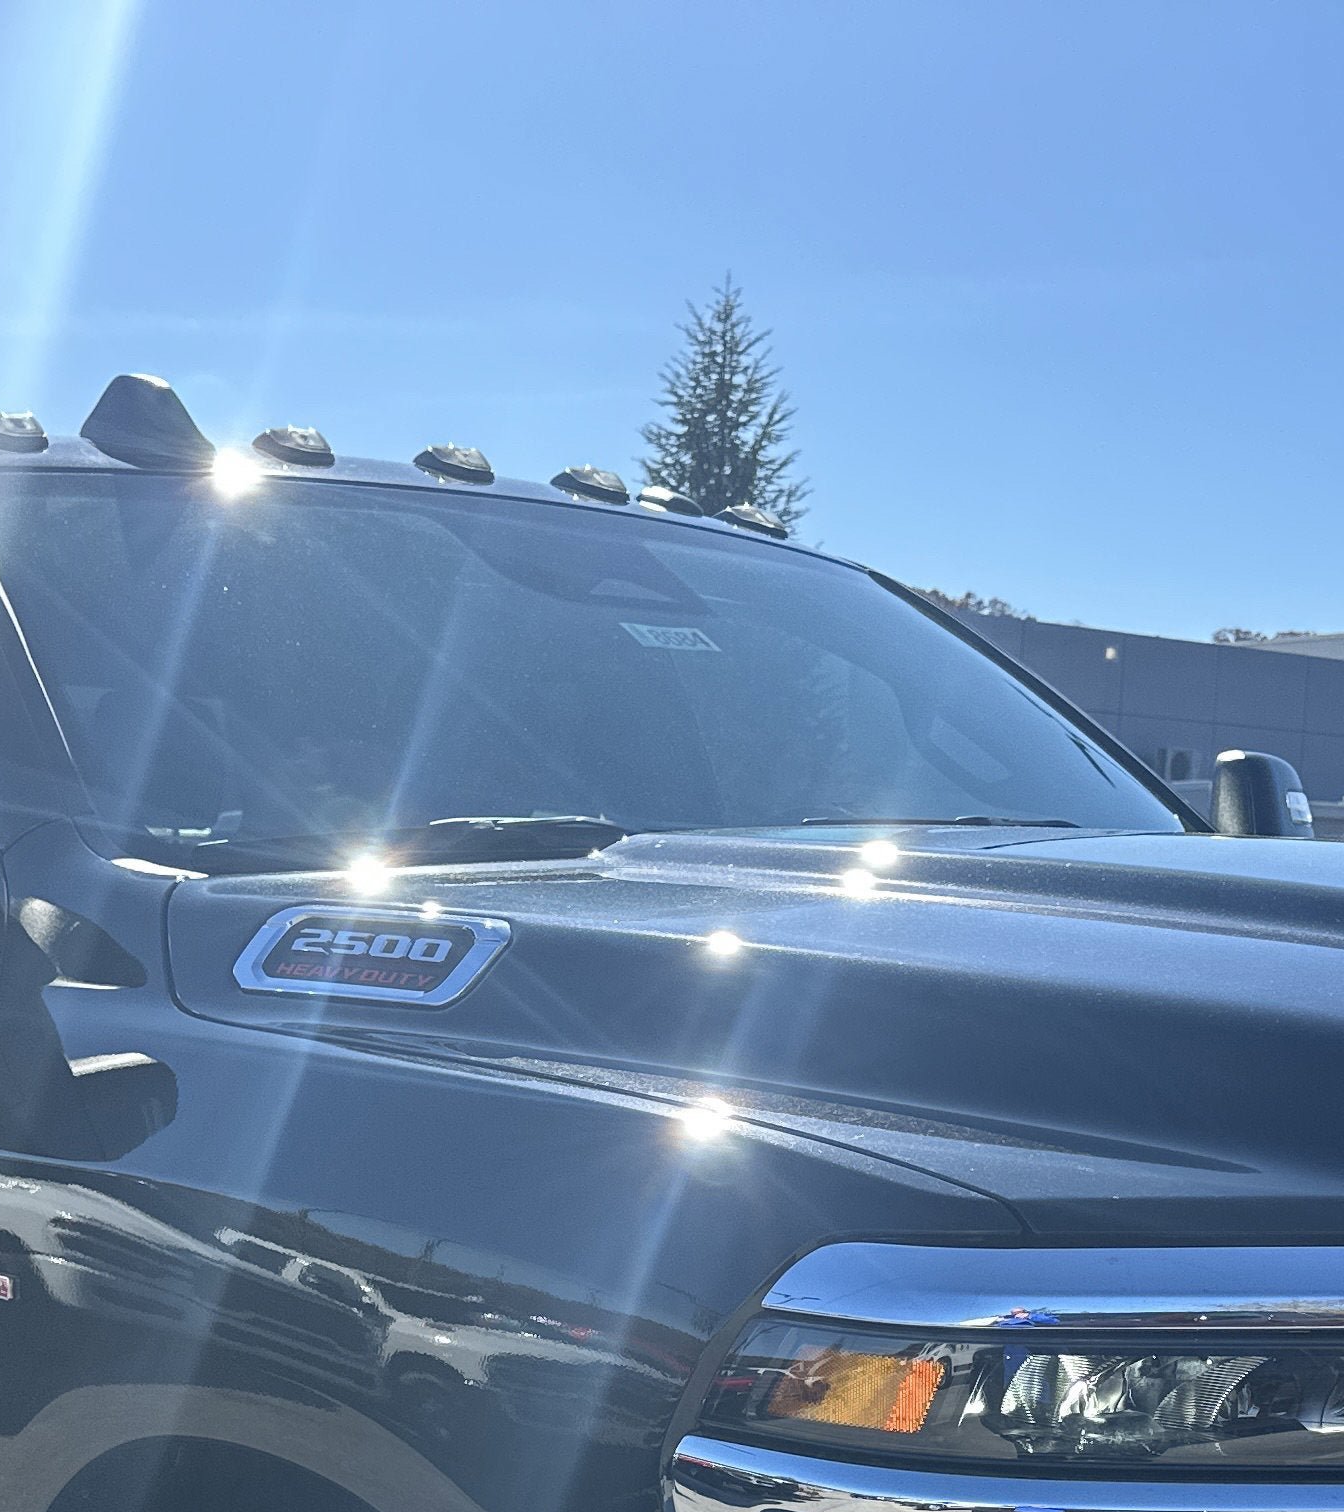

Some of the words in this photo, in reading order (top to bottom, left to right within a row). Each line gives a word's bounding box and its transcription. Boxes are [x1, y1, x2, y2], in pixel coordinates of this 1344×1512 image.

[291, 927, 454, 964] 2500
[276, 962, 361, 981] HEAVY
[358, 969, 434, 988] DUTY
